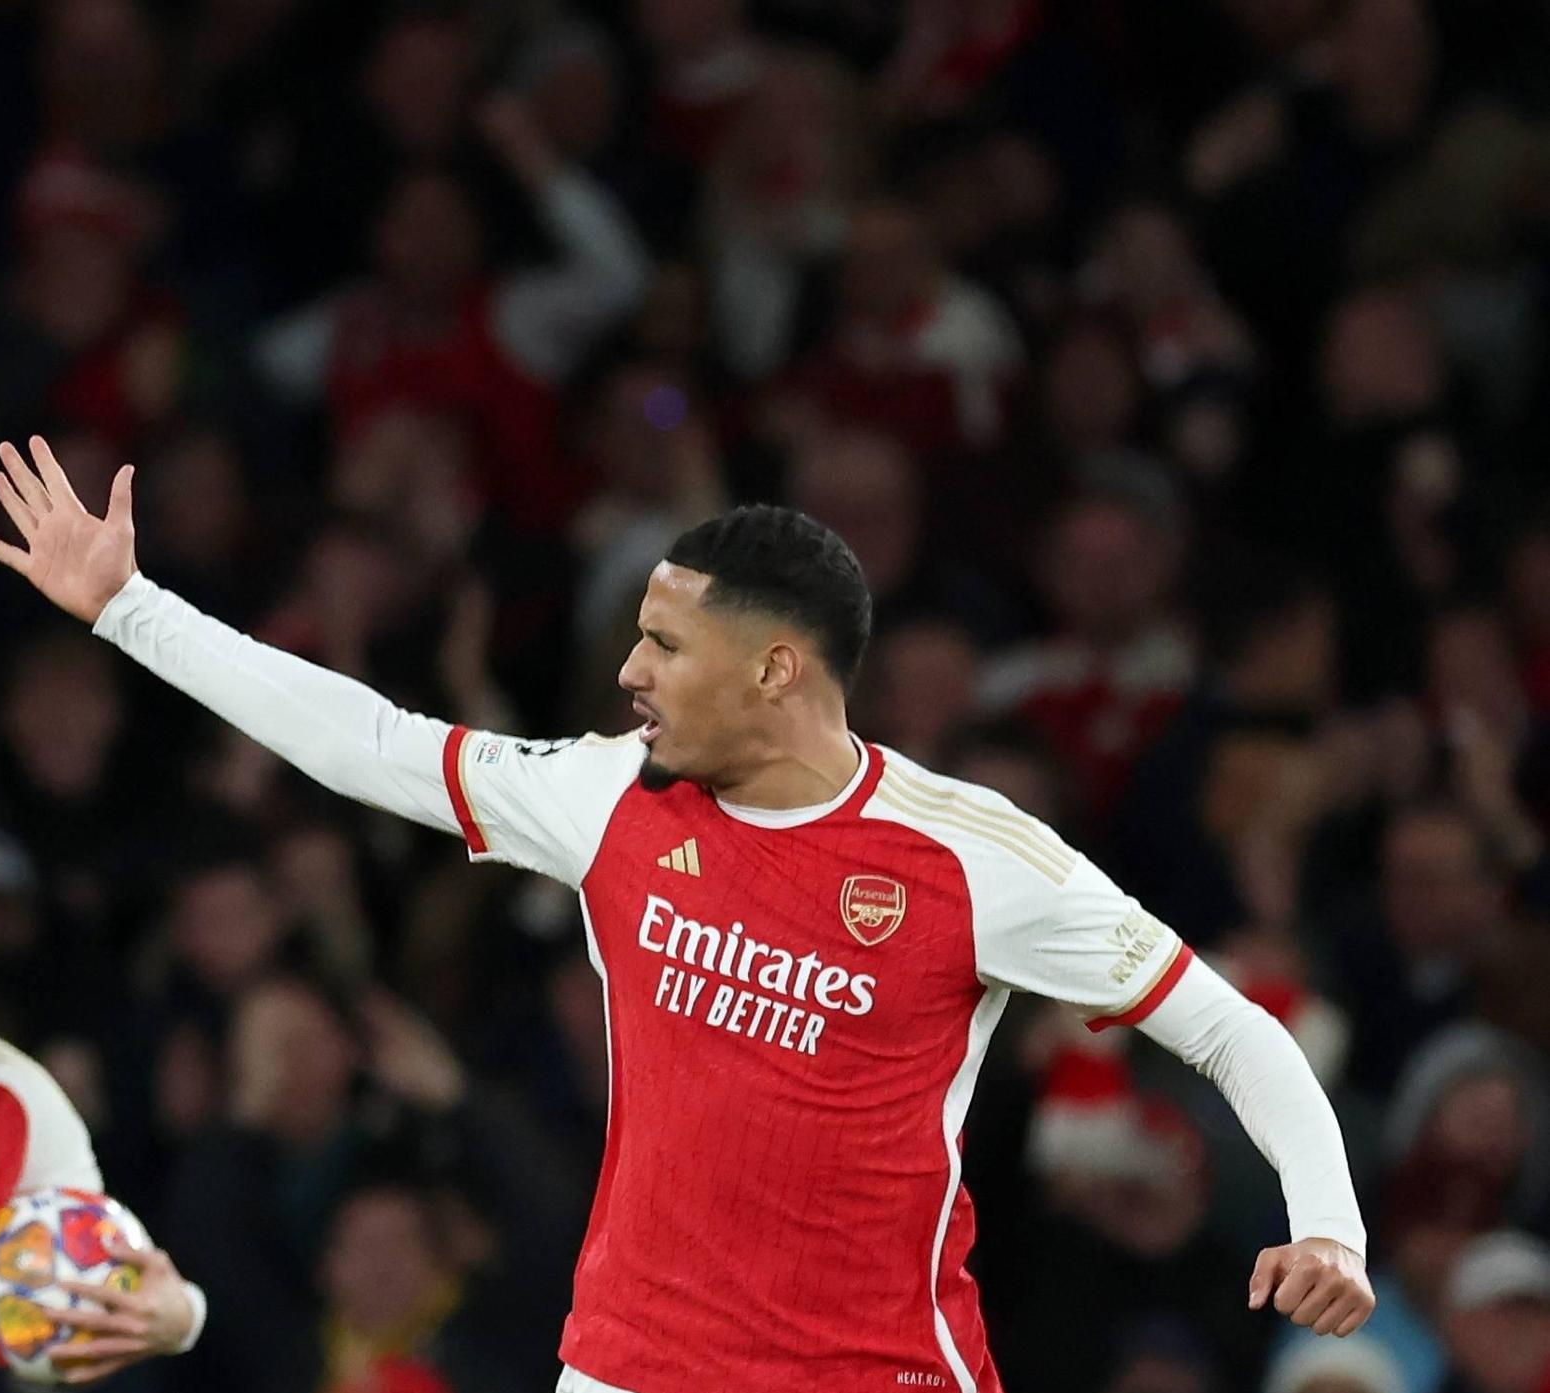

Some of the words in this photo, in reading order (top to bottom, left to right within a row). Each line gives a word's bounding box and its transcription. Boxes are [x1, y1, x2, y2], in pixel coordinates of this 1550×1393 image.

[851, 887, 897, 902] Arsenal
[638, 894, 876, 1016] Emirates
[654, 965, 706, 1017] FLY
[706, 984, 826, 1055] BETTER
